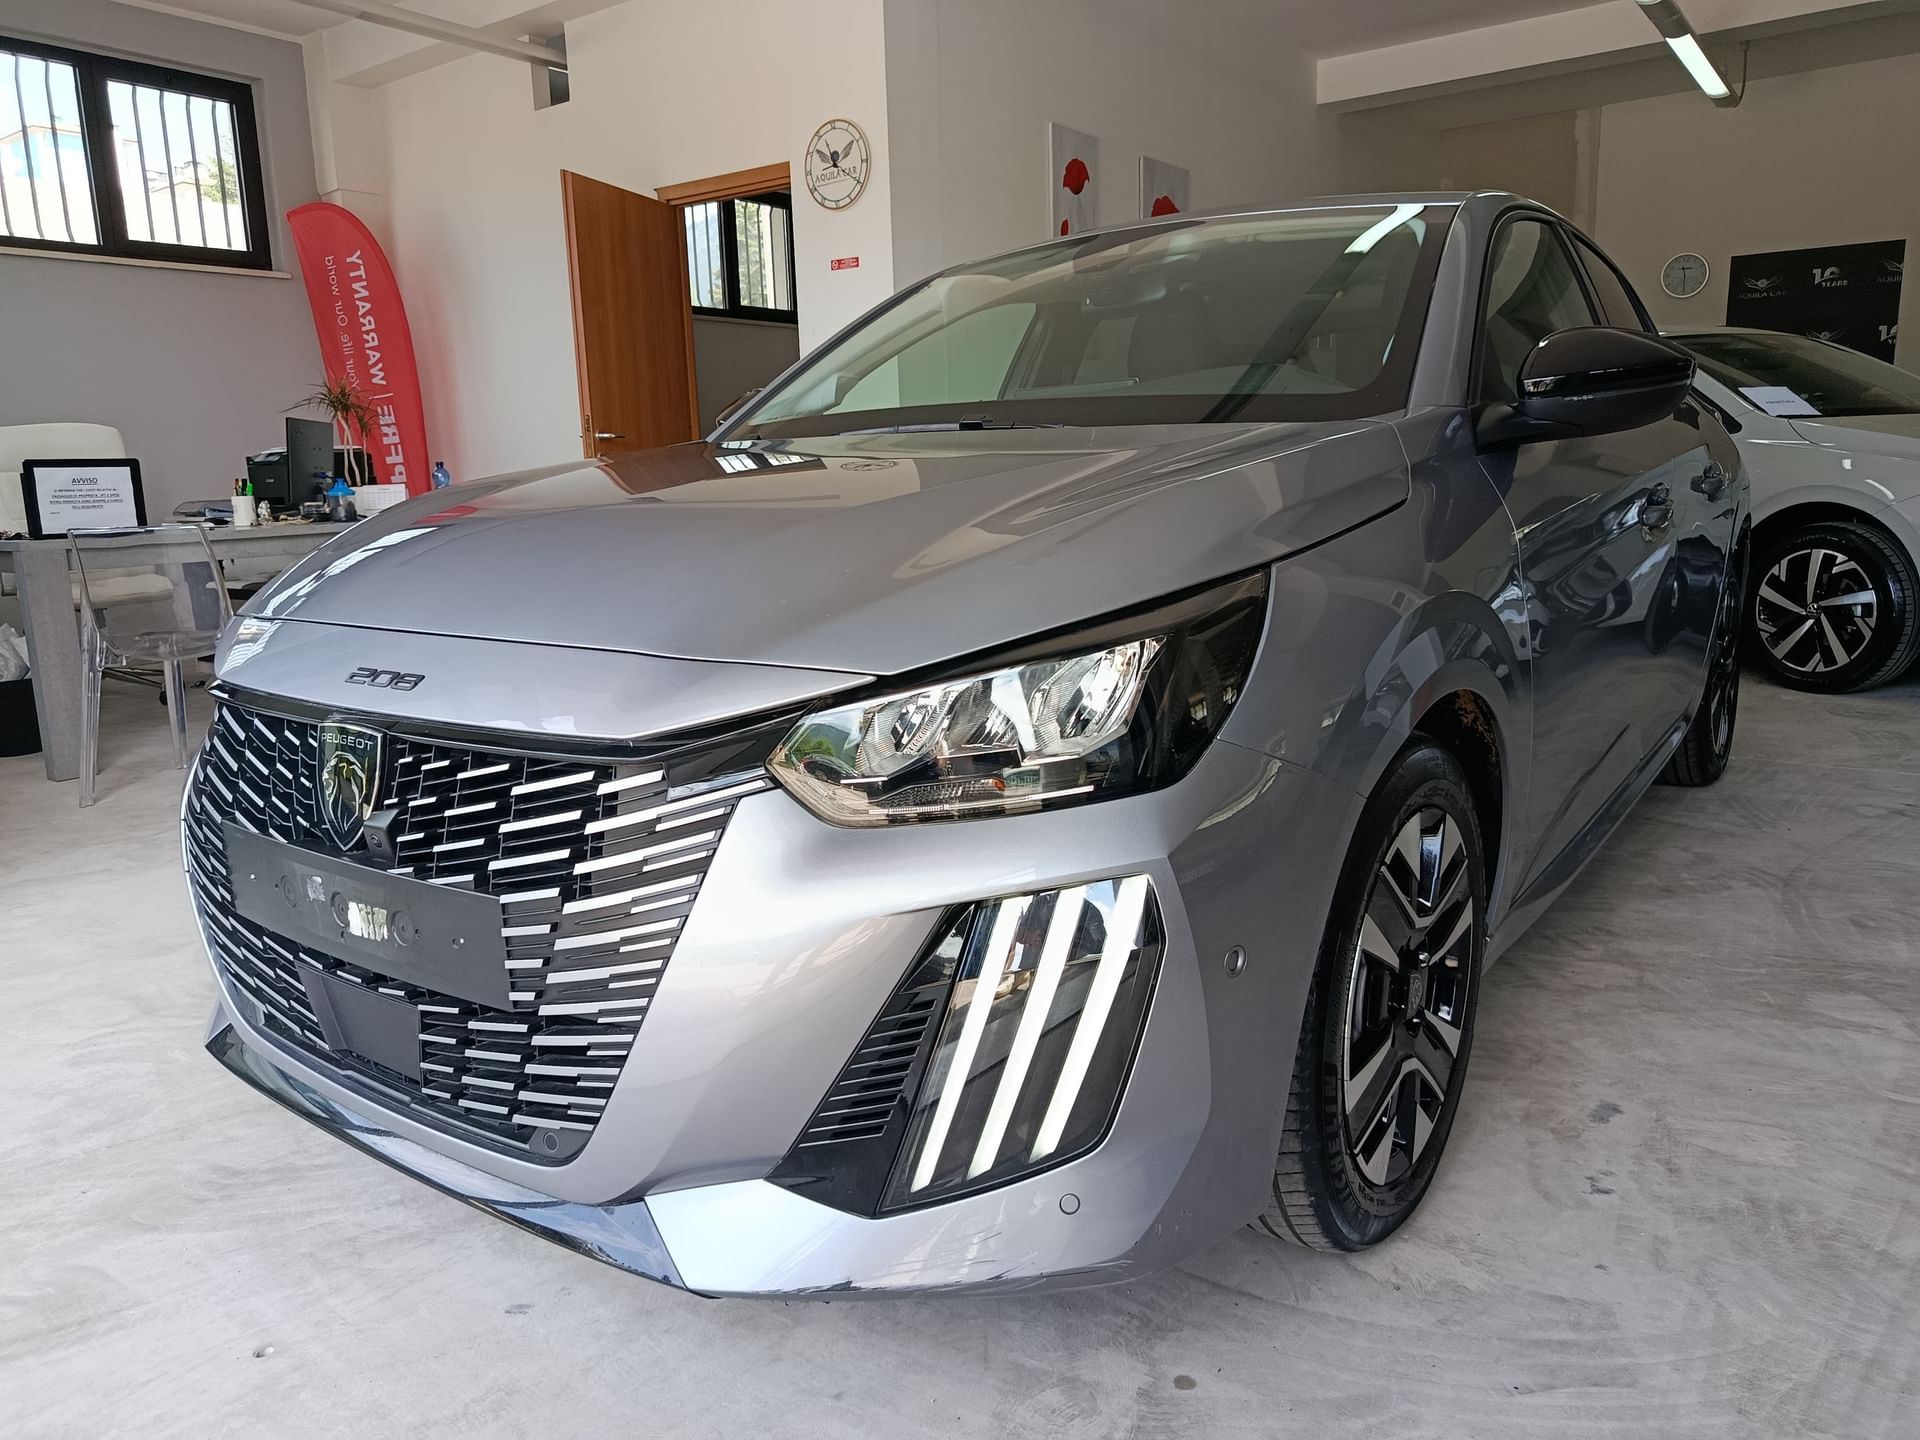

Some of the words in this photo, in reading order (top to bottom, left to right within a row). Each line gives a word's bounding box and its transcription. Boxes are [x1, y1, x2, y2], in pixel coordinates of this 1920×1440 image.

[815, 168, 841, 184] AQUILA
[72, 477, 98, 485] AVVISO
[345, 666, 426, 692] 208
[321, 732, 374, 751] PEUGEOT
